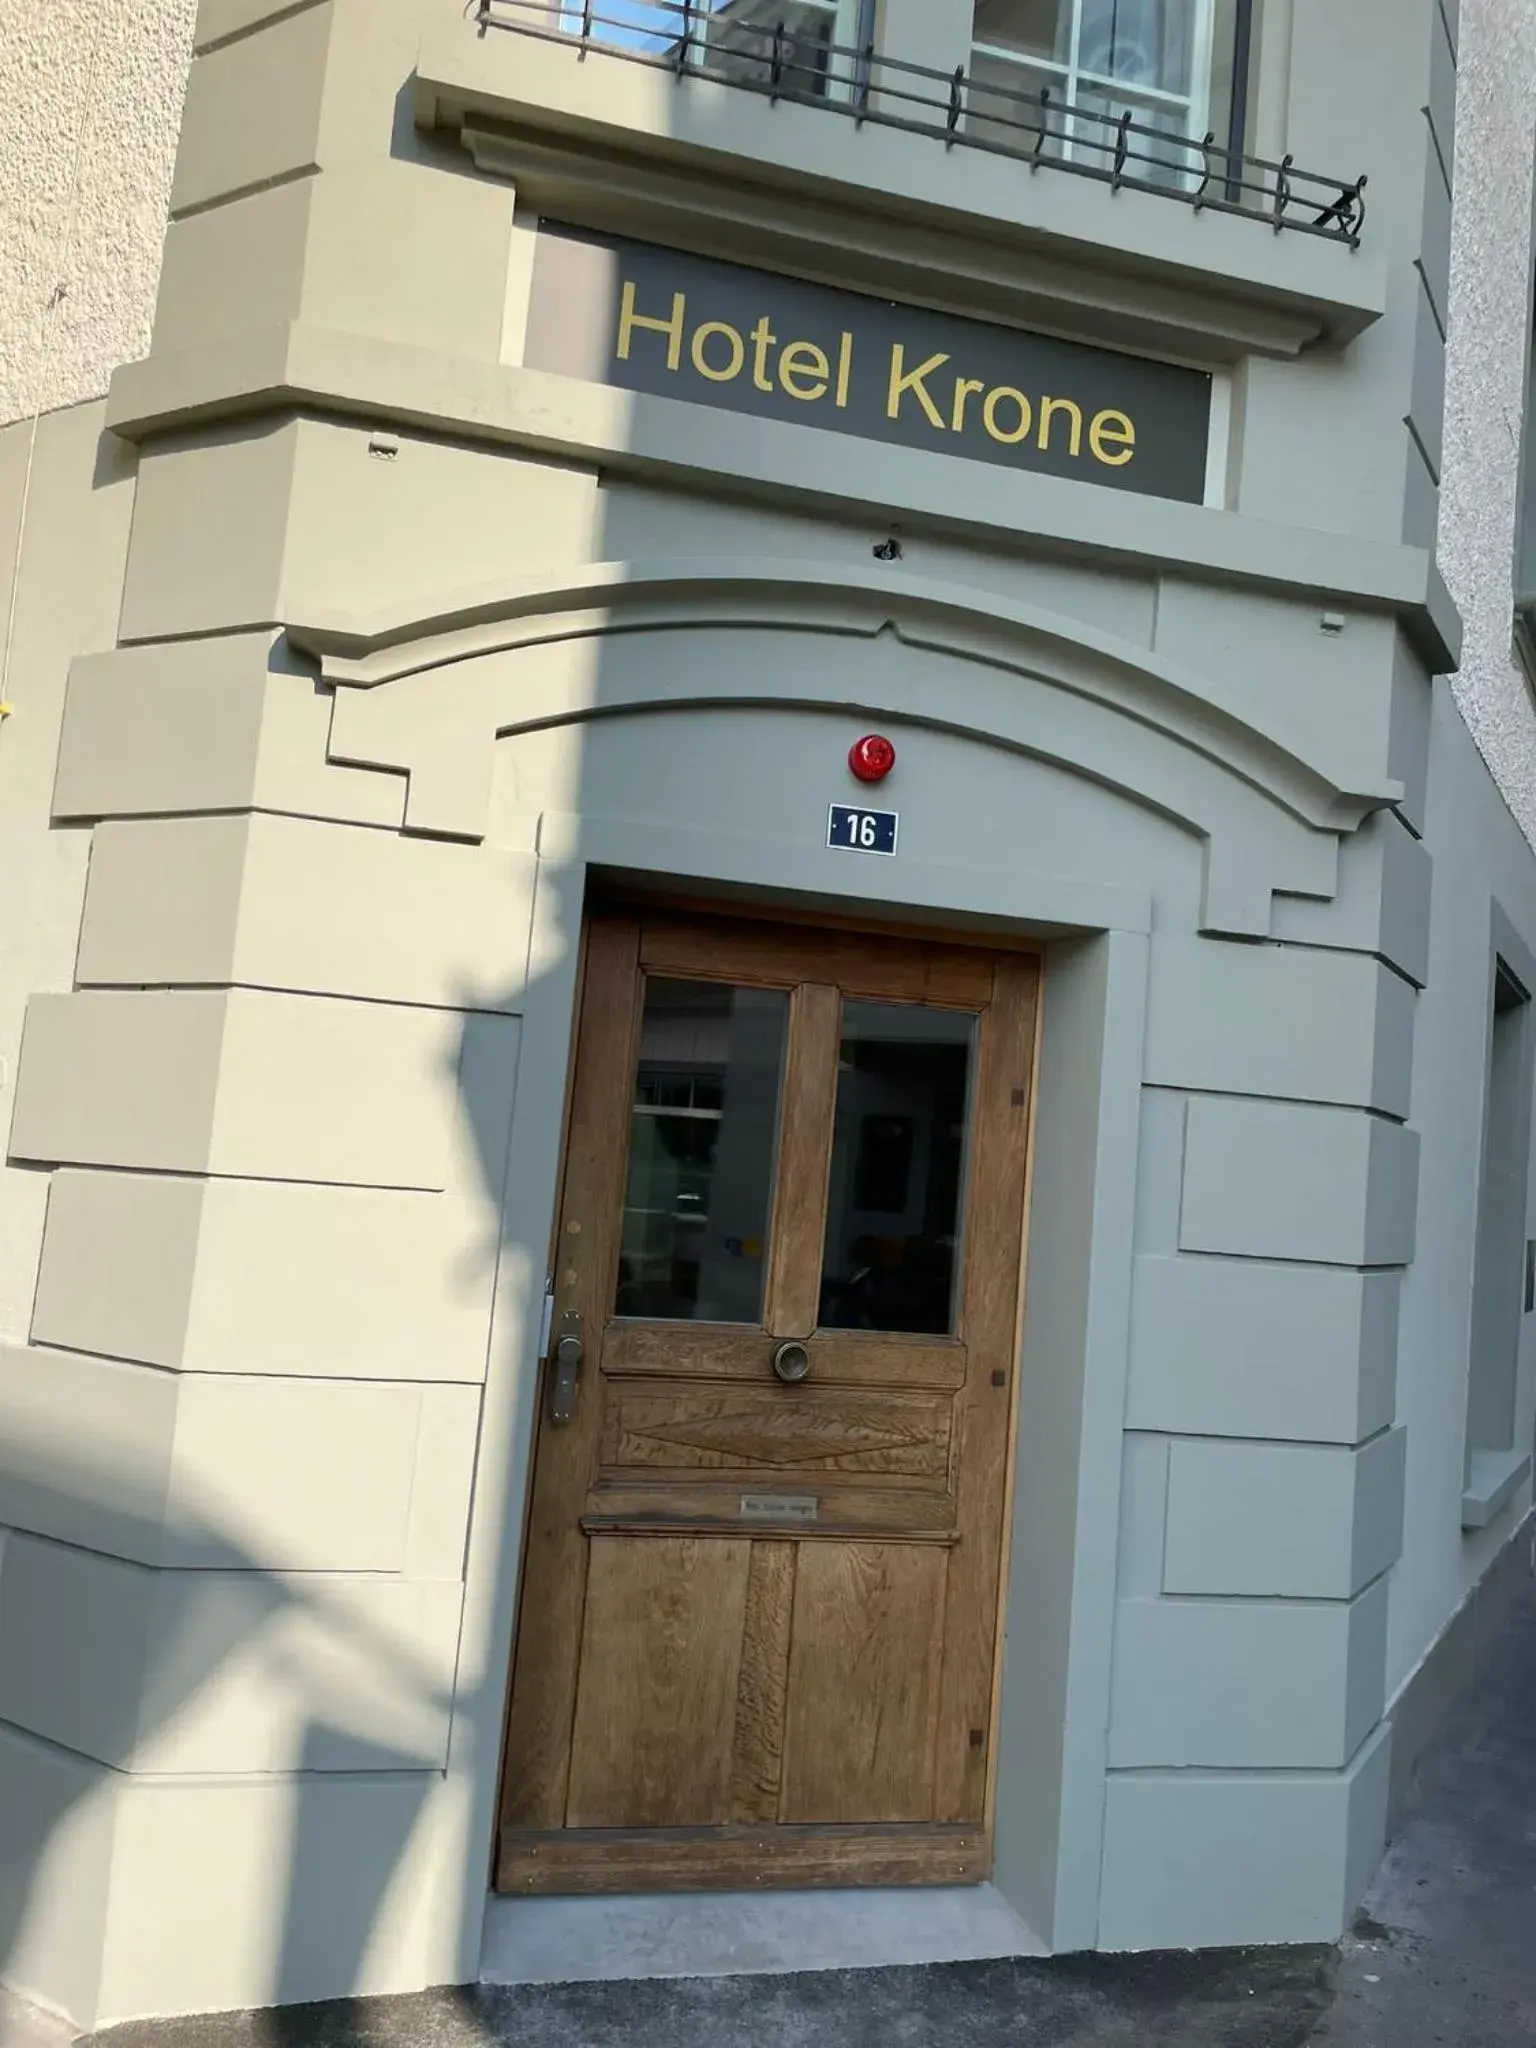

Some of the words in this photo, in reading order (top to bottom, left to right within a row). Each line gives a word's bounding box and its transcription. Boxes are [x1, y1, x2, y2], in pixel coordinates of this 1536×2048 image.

[616, 281, 853, 407] Hotel
[887, 344, 1136, 466] Krone
[847, 814, 877, 847] 16
